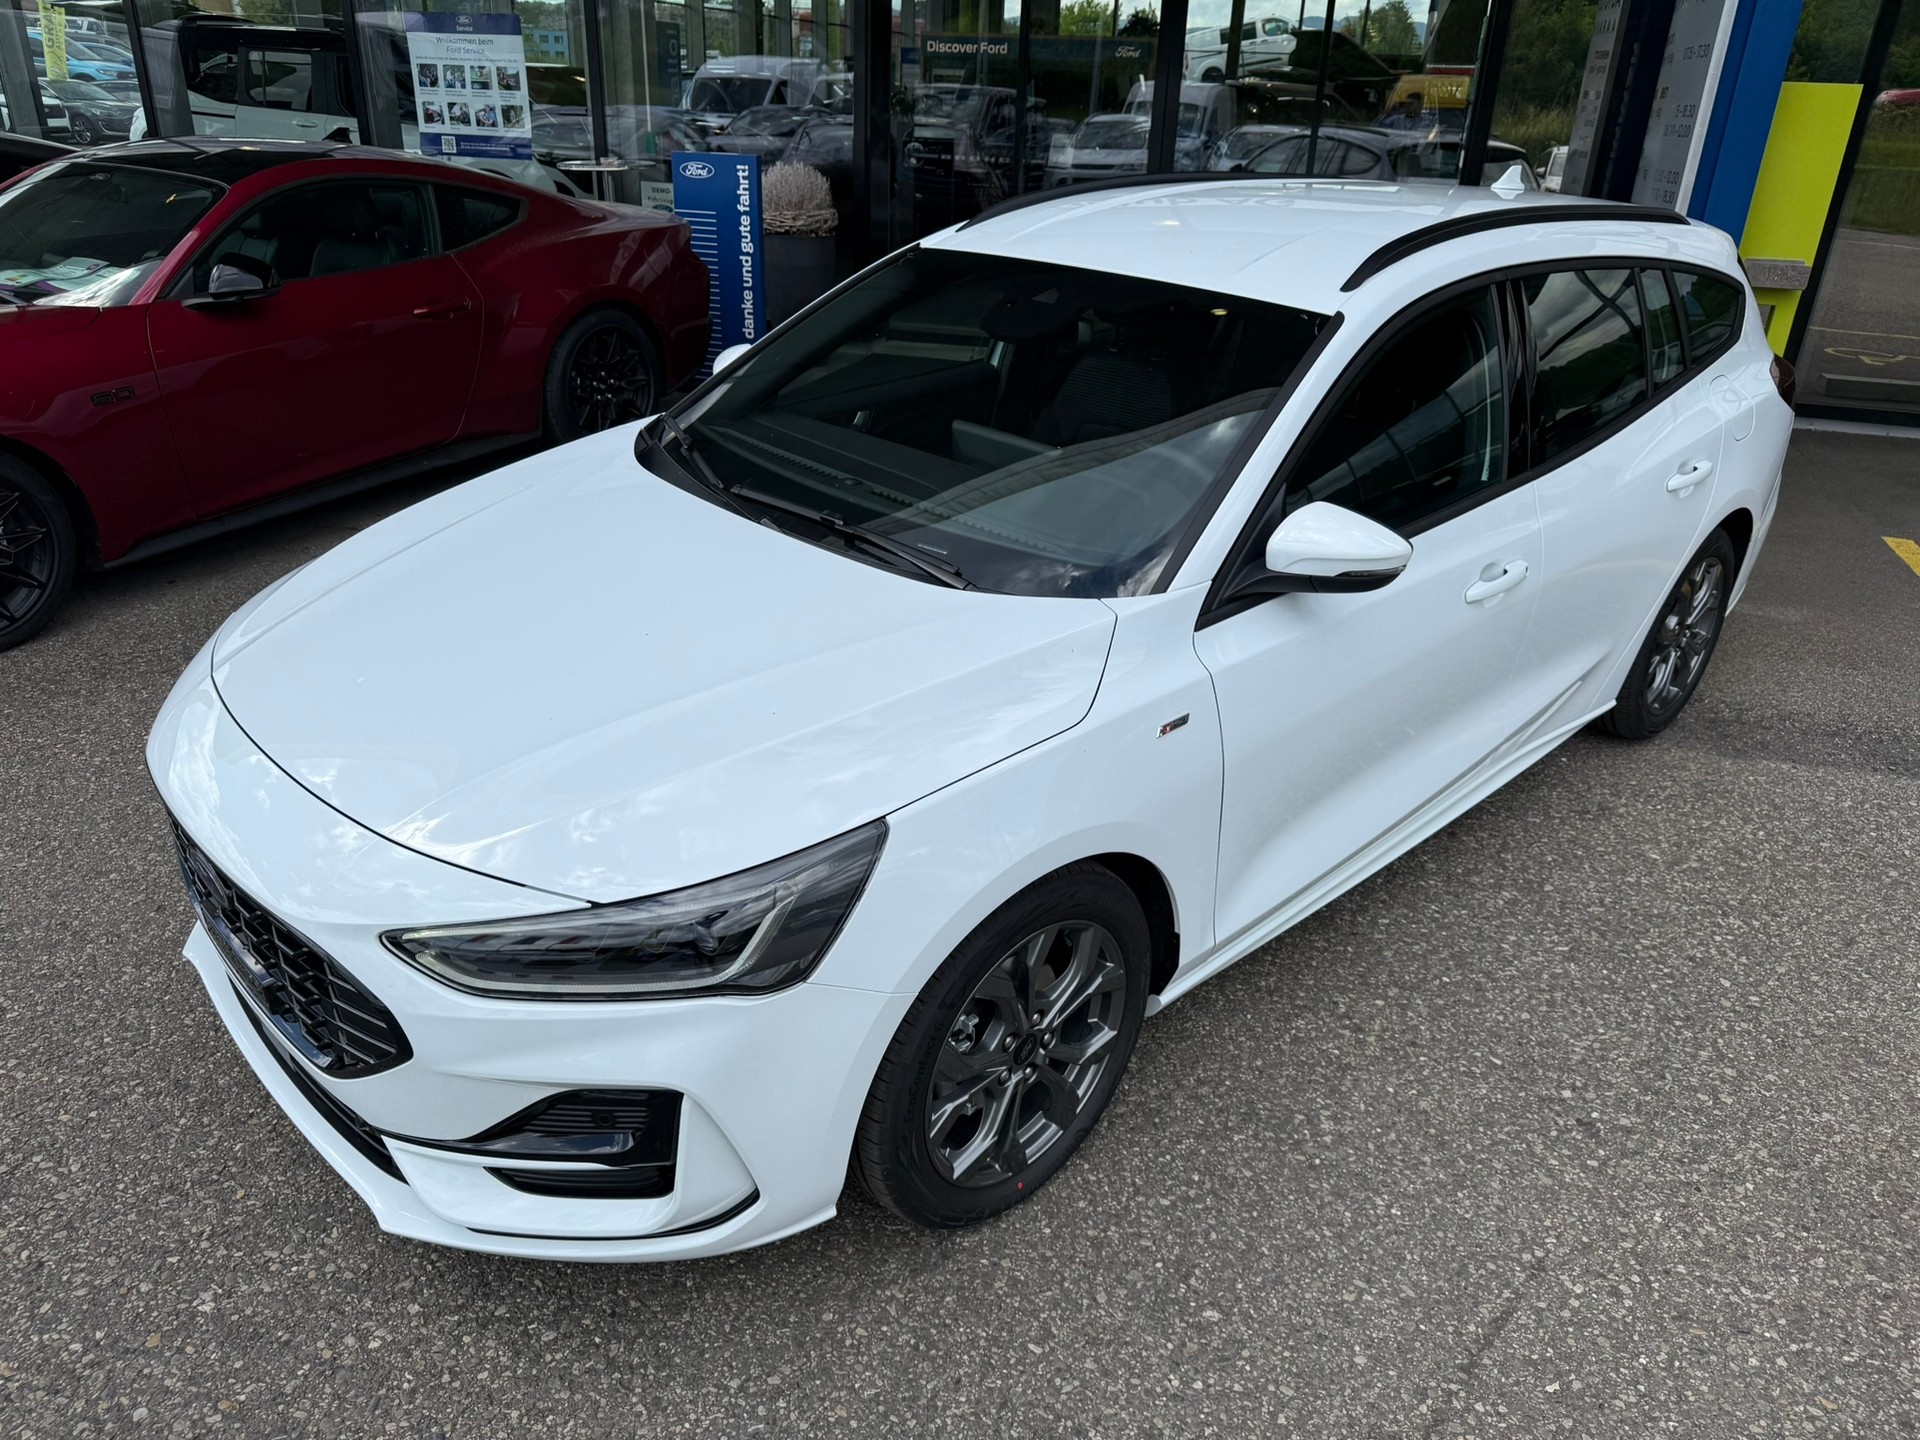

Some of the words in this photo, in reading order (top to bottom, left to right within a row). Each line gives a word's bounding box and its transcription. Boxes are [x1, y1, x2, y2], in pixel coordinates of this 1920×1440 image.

[456, 24, 473, 32] Service
[446, 46, 461, 54] Ford
[462, 47, 486, 55] Service
[926, 40, 978, 53] Discover
[980, 41, 1008, 54] Ford
[1115, 45, 1142, 58] Ford
[684, 162, 712, 177] Ford
[736, 164, 750, 213] fahrt!
[739, 215, 754, 254] gute
[739, 255, 753, 287] und
[741, 290, 755, 339] danke
